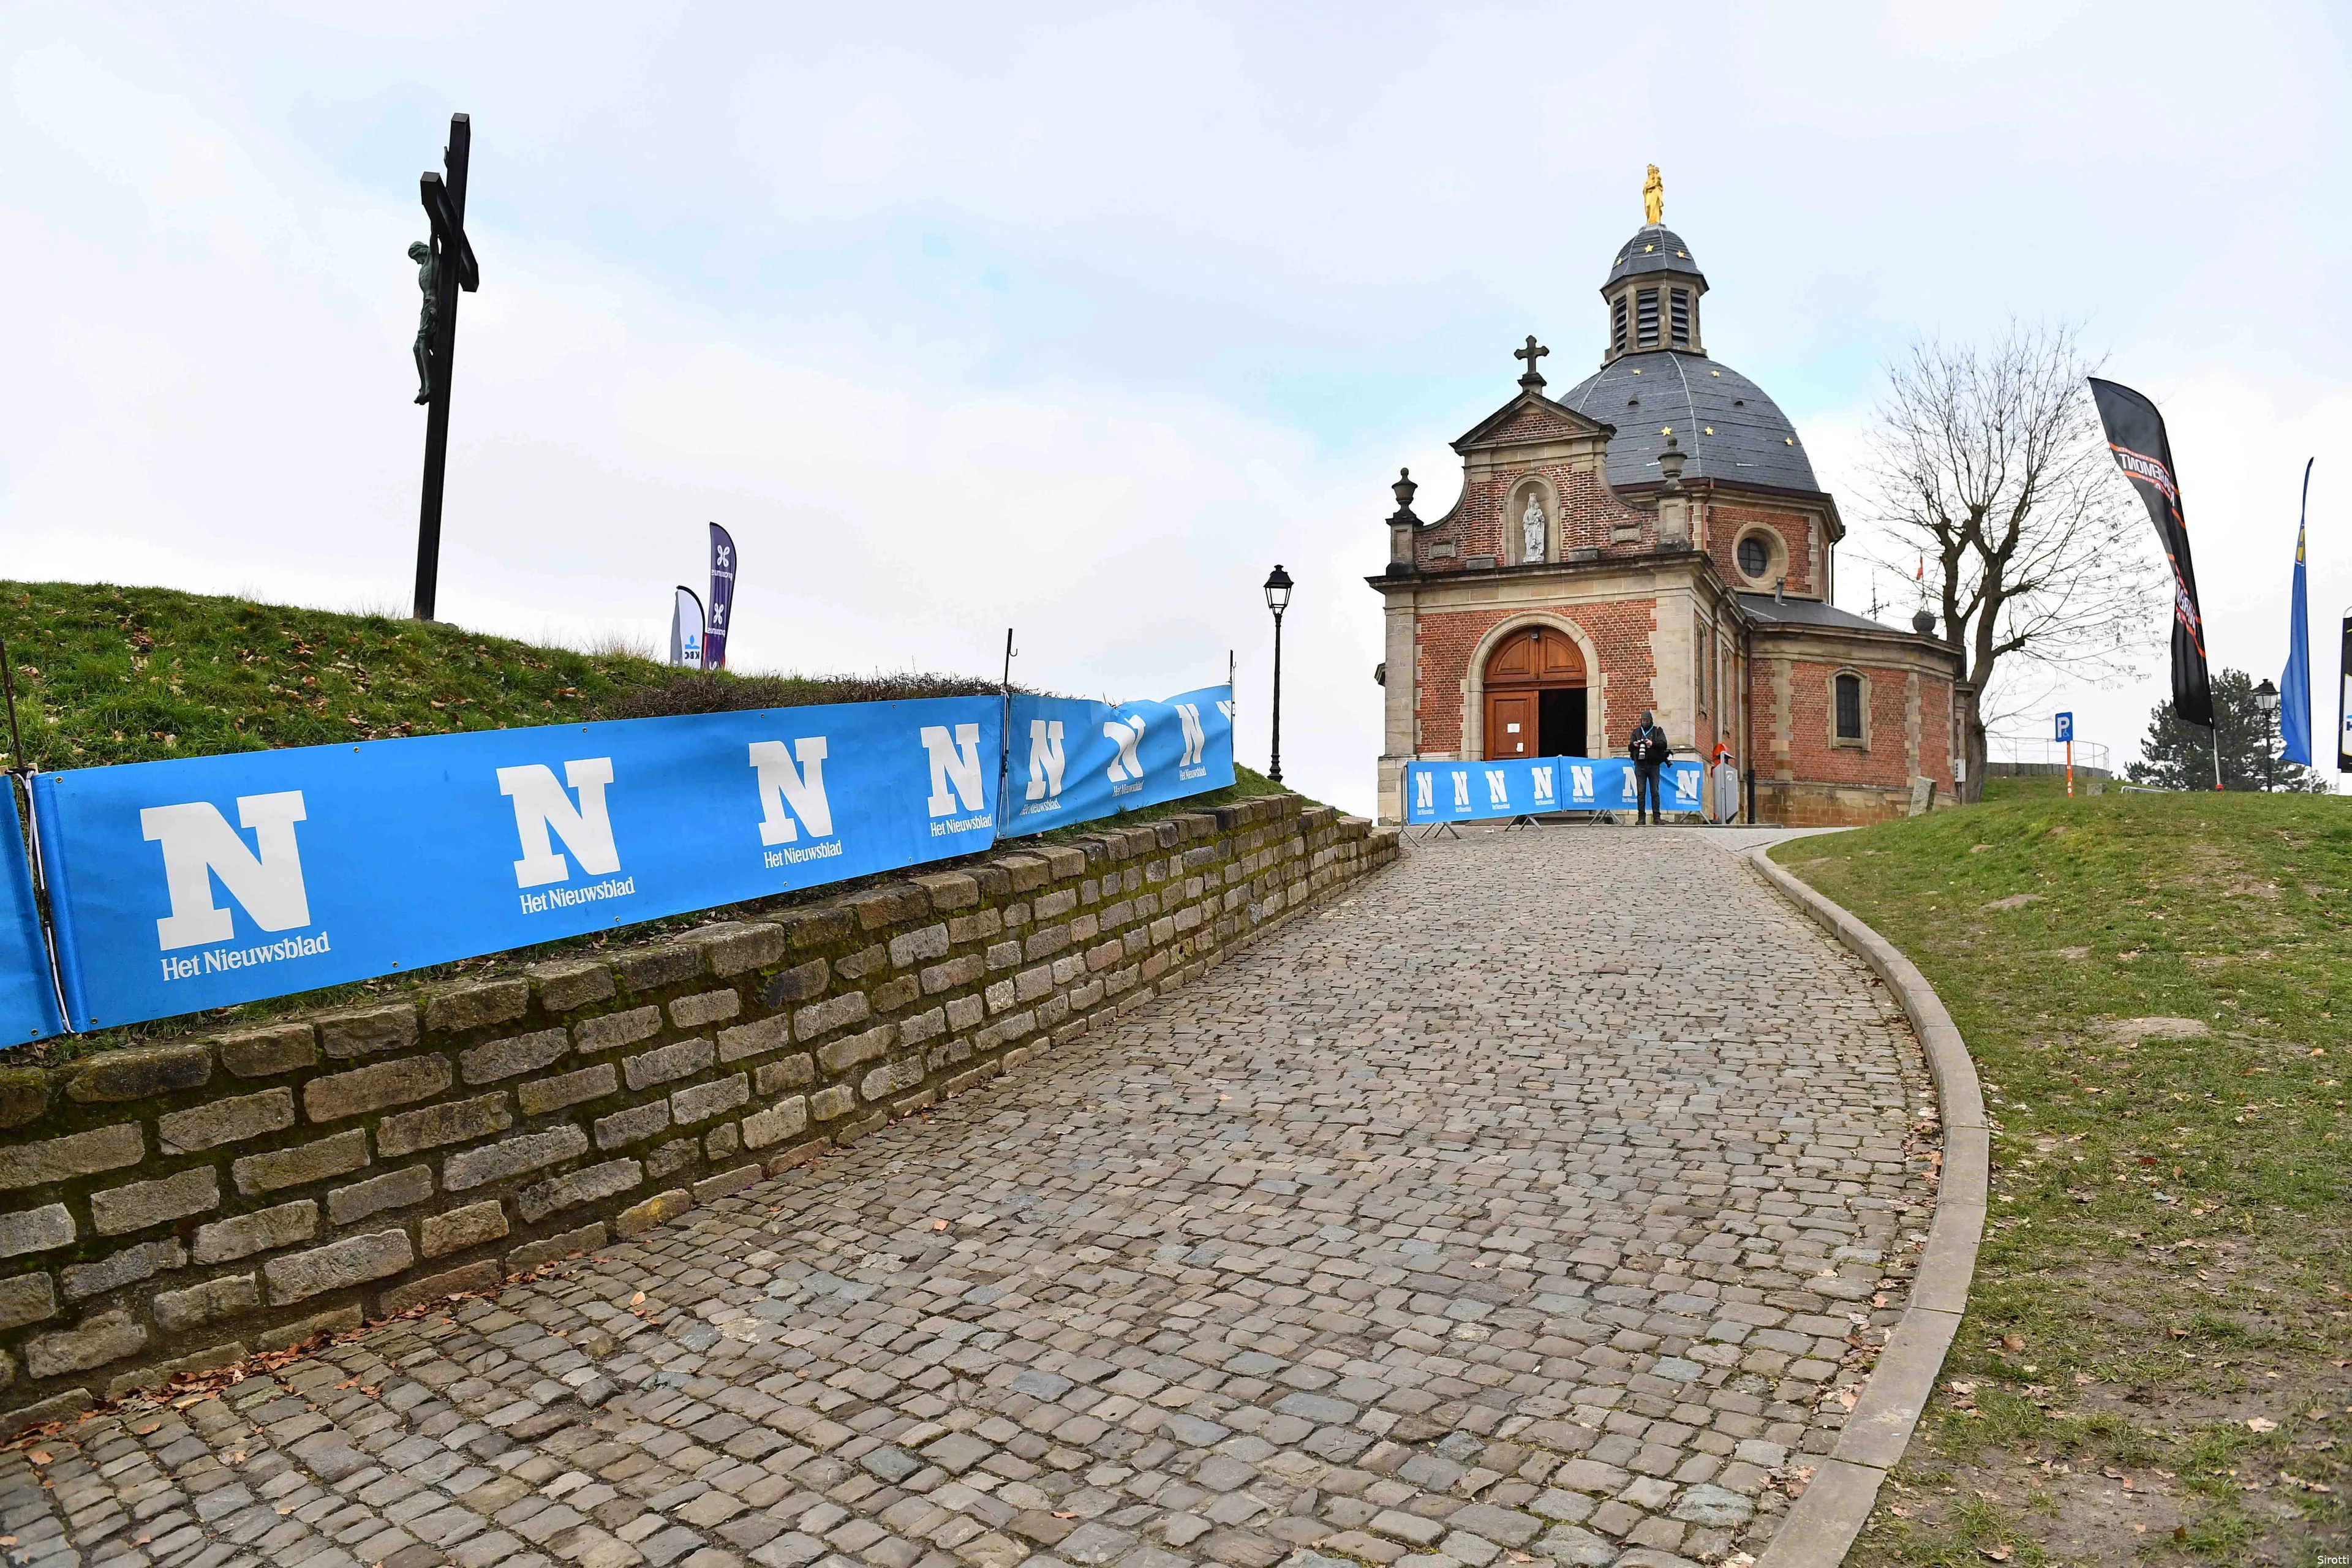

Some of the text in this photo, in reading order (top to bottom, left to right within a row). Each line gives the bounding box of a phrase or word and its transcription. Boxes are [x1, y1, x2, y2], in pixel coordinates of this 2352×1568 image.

[1174, 704, 1205, 767] N
[2058, 716, 2070, 739] P
[921, 723, 985, 817] N
[1026, 720, 1065, 800] N
[748, 736, 834, 846] N
[1416, 772, 1433, 808] N
[1452, 771, 1469, 805] N
[1485, 770, 1508, 804] N
[1531, 766, 1553, 799] N
[1571, 766, 1594, 796] N
[1676, 769, 1700, 799] N
[496, 757, 621, 889] N
[930, 813, 993, 837] Het Nieuwsblad
[140, 790, 311, 951] N
[764, 839, 843, 869] Het Nieuwsblad
[519, 876, 636, 914] Het Nieuwsblad
[160, 931, 331, 981] Het Nieuwsblad
